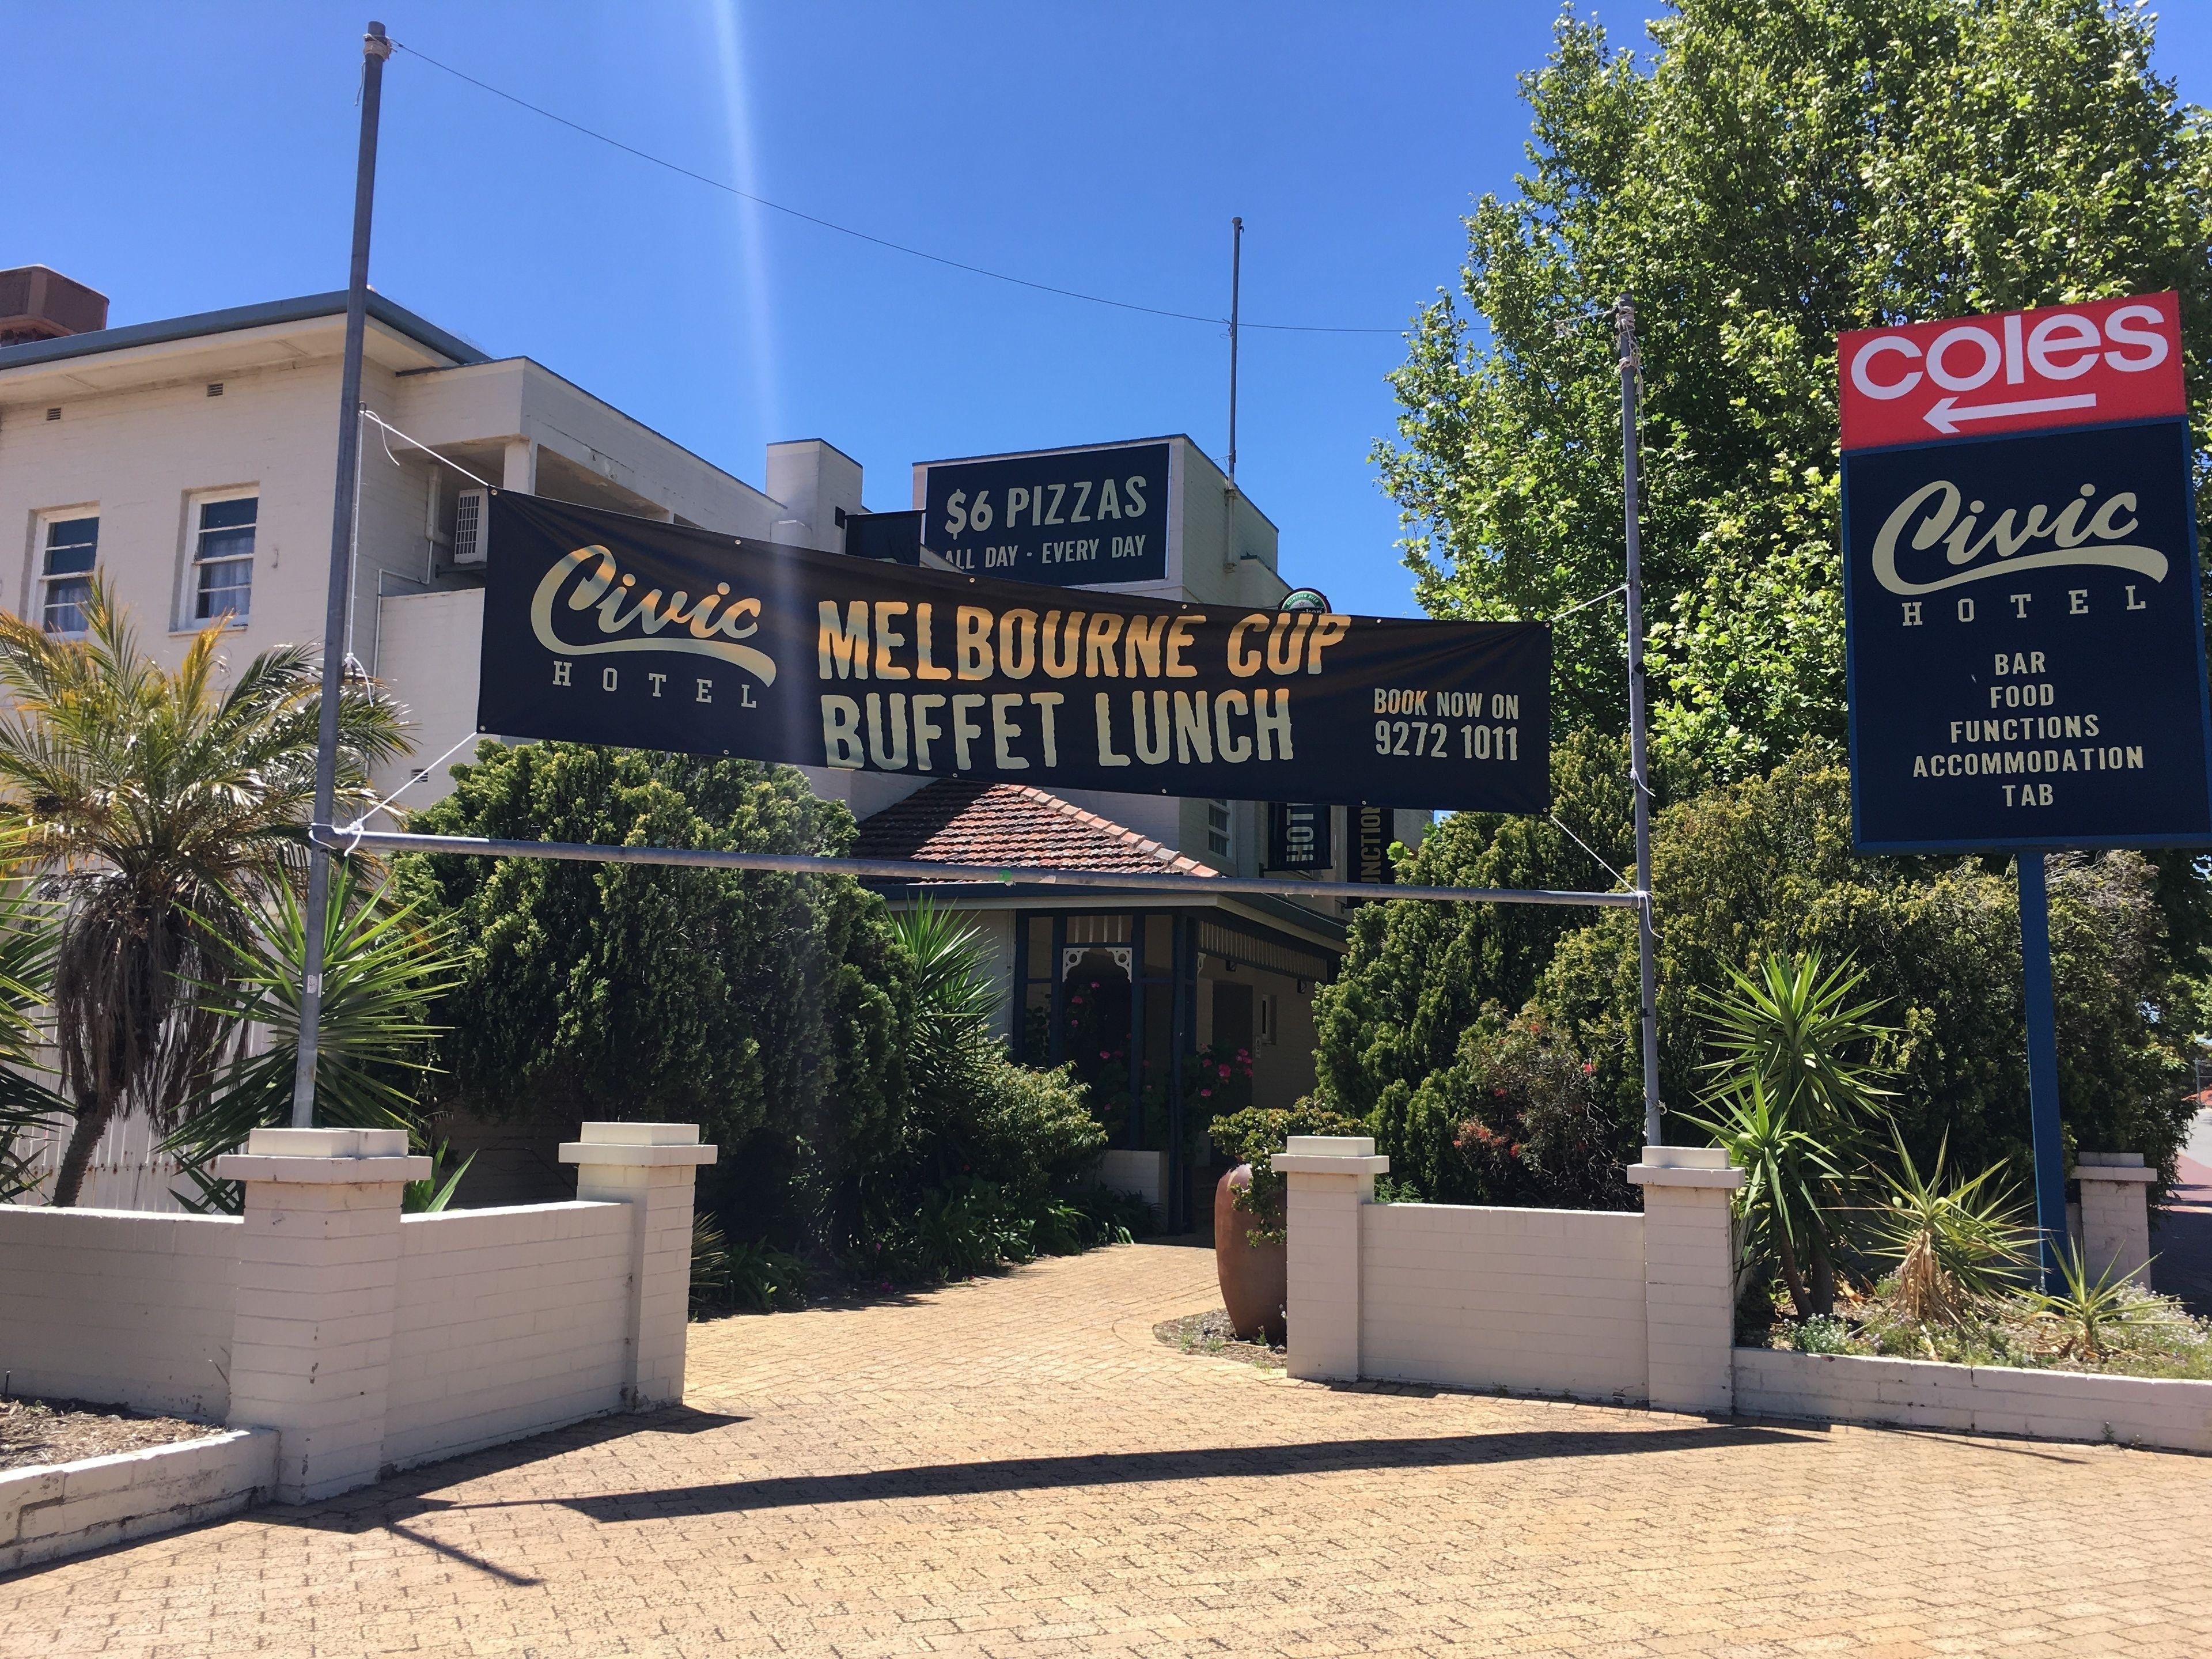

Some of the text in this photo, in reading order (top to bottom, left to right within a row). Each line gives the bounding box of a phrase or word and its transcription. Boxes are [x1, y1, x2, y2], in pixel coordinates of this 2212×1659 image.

[1851, 305, 2169, 400] coles
[945, 476, 1147, 540] $6 PIZZAS
[986, 545, 1018, 568] DAY
[1042, 538, 1099, 563] EVERY
[1112, 535, 1146, 558] DAY
[1872, 480, 2168, 595] Civic
[531, 545, 777, 687] Civic
[1902, 585, 2146, 626] HOTEL
[819, 601, 1352, 681] MELBOURNE CUP
[552, 660, 757, 709] HOTEL
[1995, 651, 2046, 676] BAR
[1374, 688, 1518, 720] BOOK NOW ON
[1990, 684, 2054, 709] FOOD
[822, 688, 1294, 771] BUFFET LUNCH
[1375, 720, 1517, 762] 9272 1011
[1950, 714, 2099, 743] FUNCTIONS
[1913, 746, 2143, 778] ACCOMMODATION
[2002, 784, 2054, 807] TAB
[1286, 803, 1313, 861] HOT
